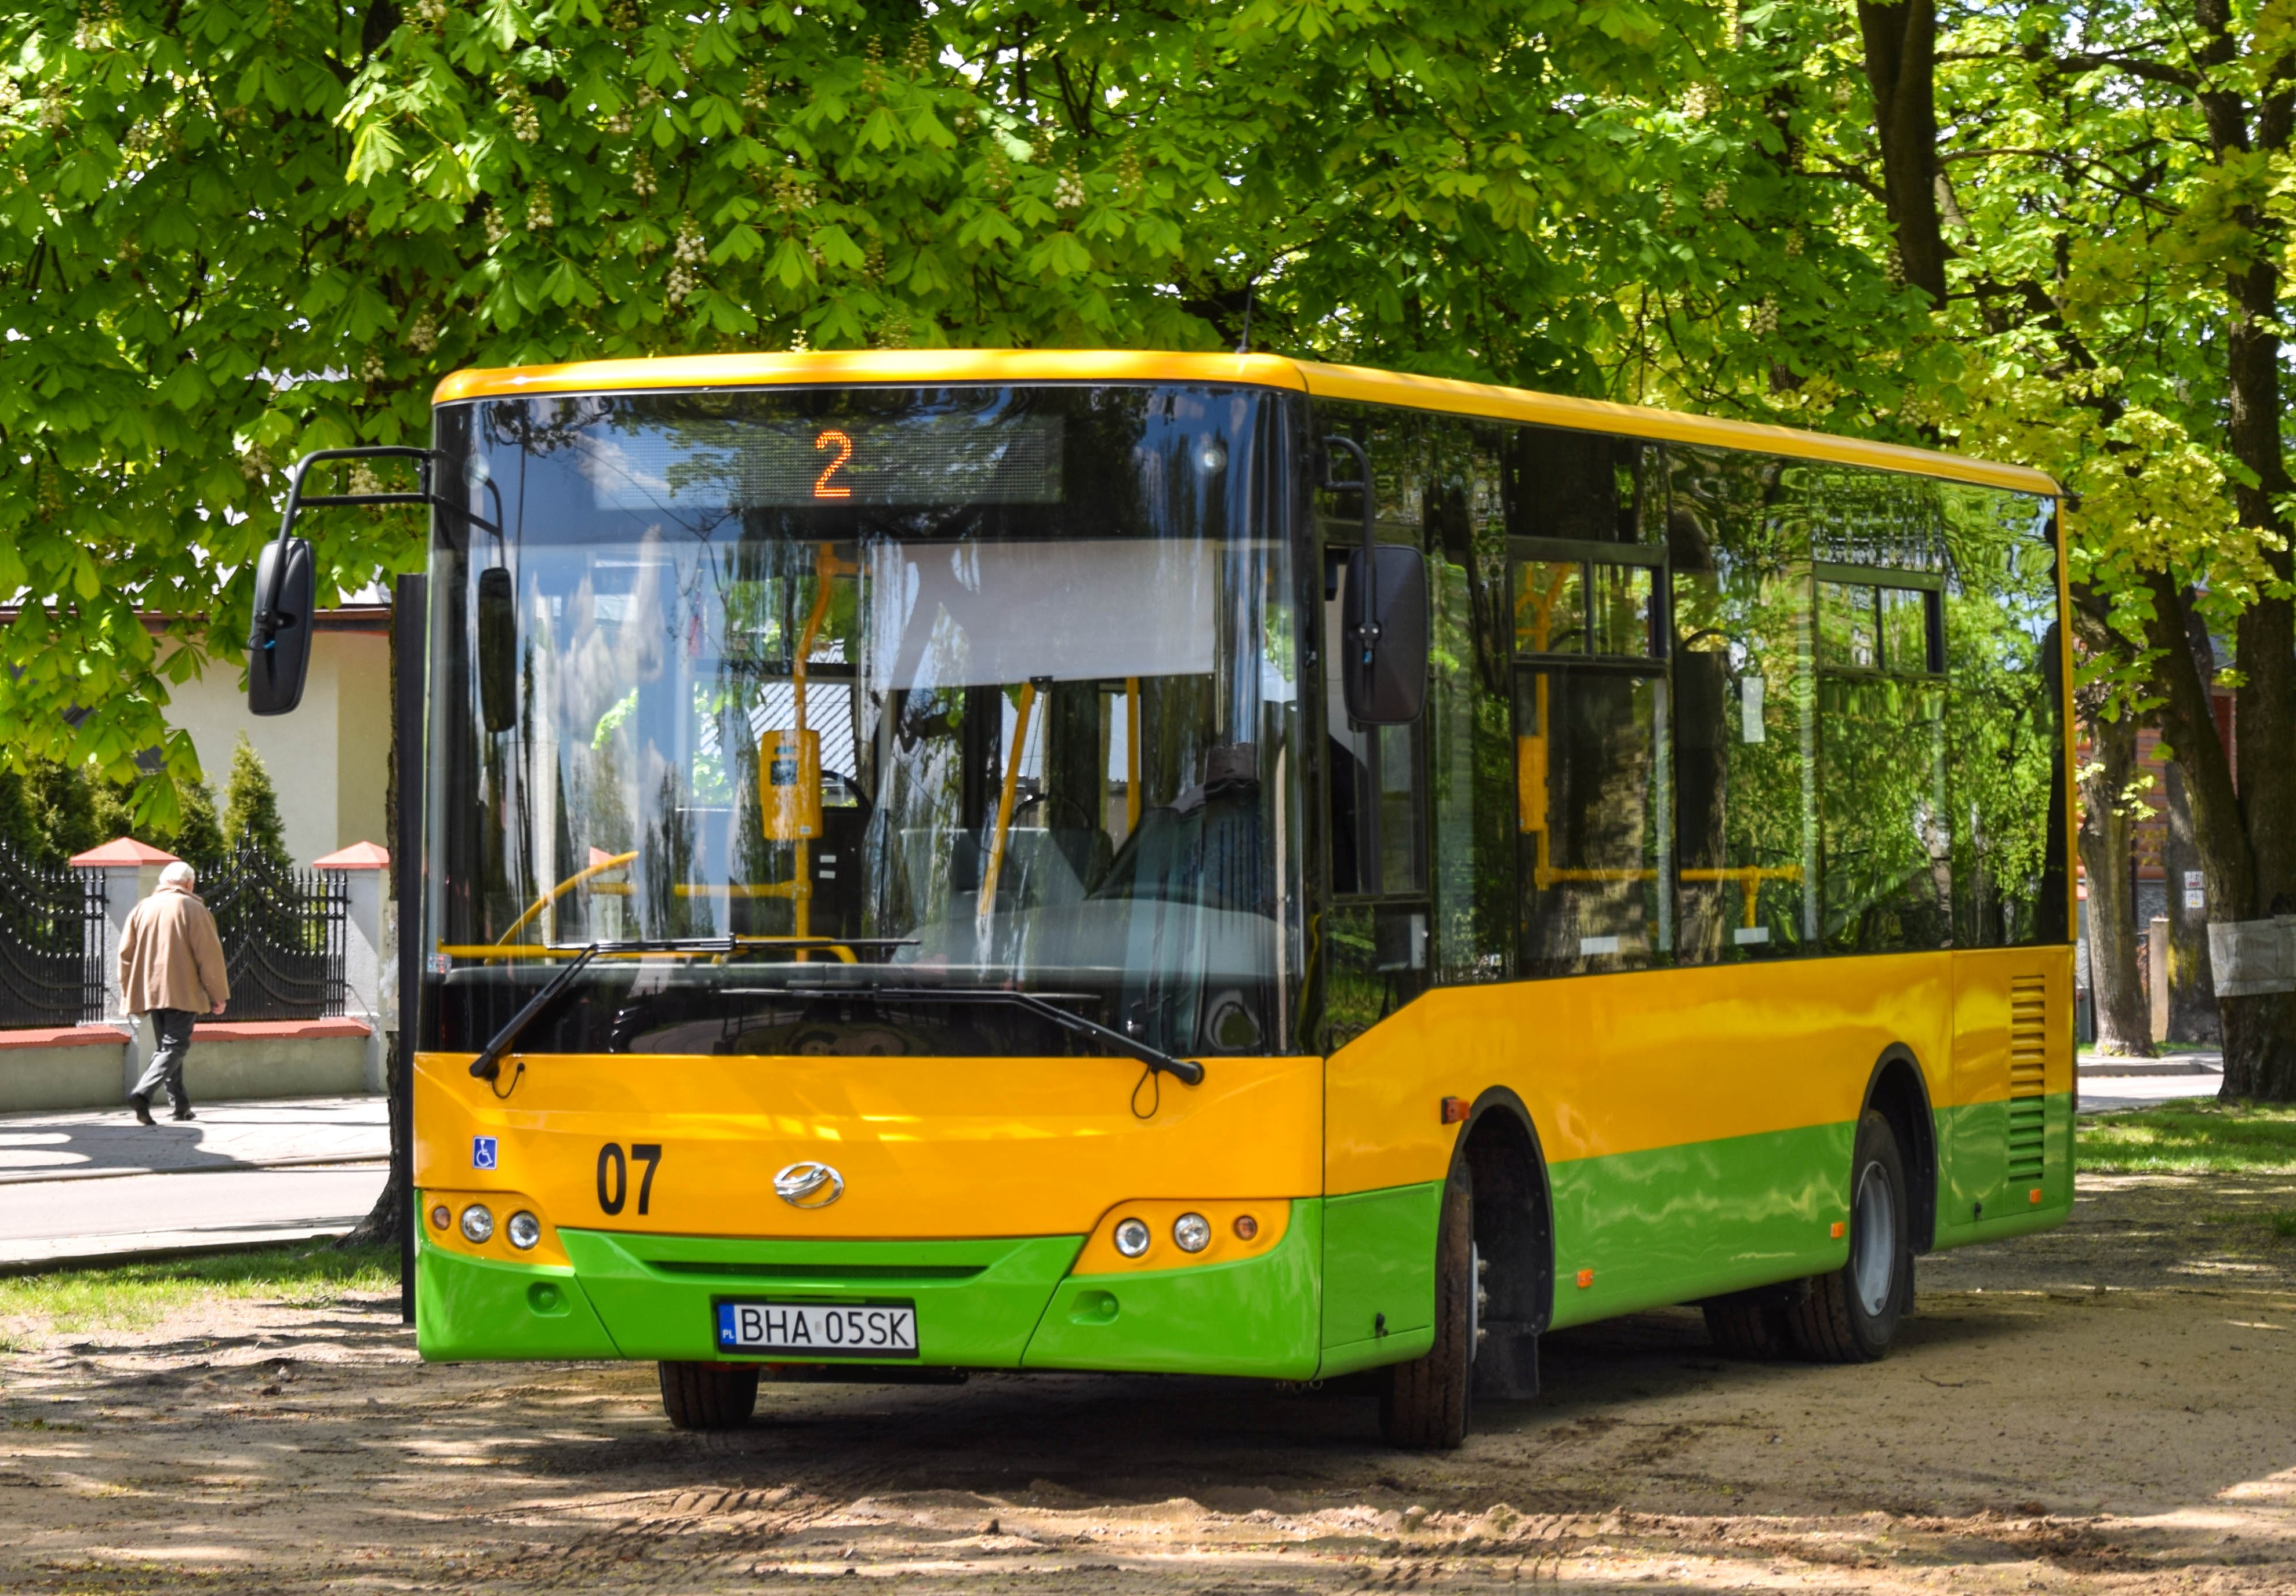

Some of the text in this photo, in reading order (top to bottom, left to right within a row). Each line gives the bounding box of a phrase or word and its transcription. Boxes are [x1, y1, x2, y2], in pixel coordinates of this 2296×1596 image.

[815, 431, 851, 497] 2
[597, 1143, 662, 1215] 07
[723, 1330, 735, 1339] PL
[741, 1309, 909, 1346] BHA 05SK
